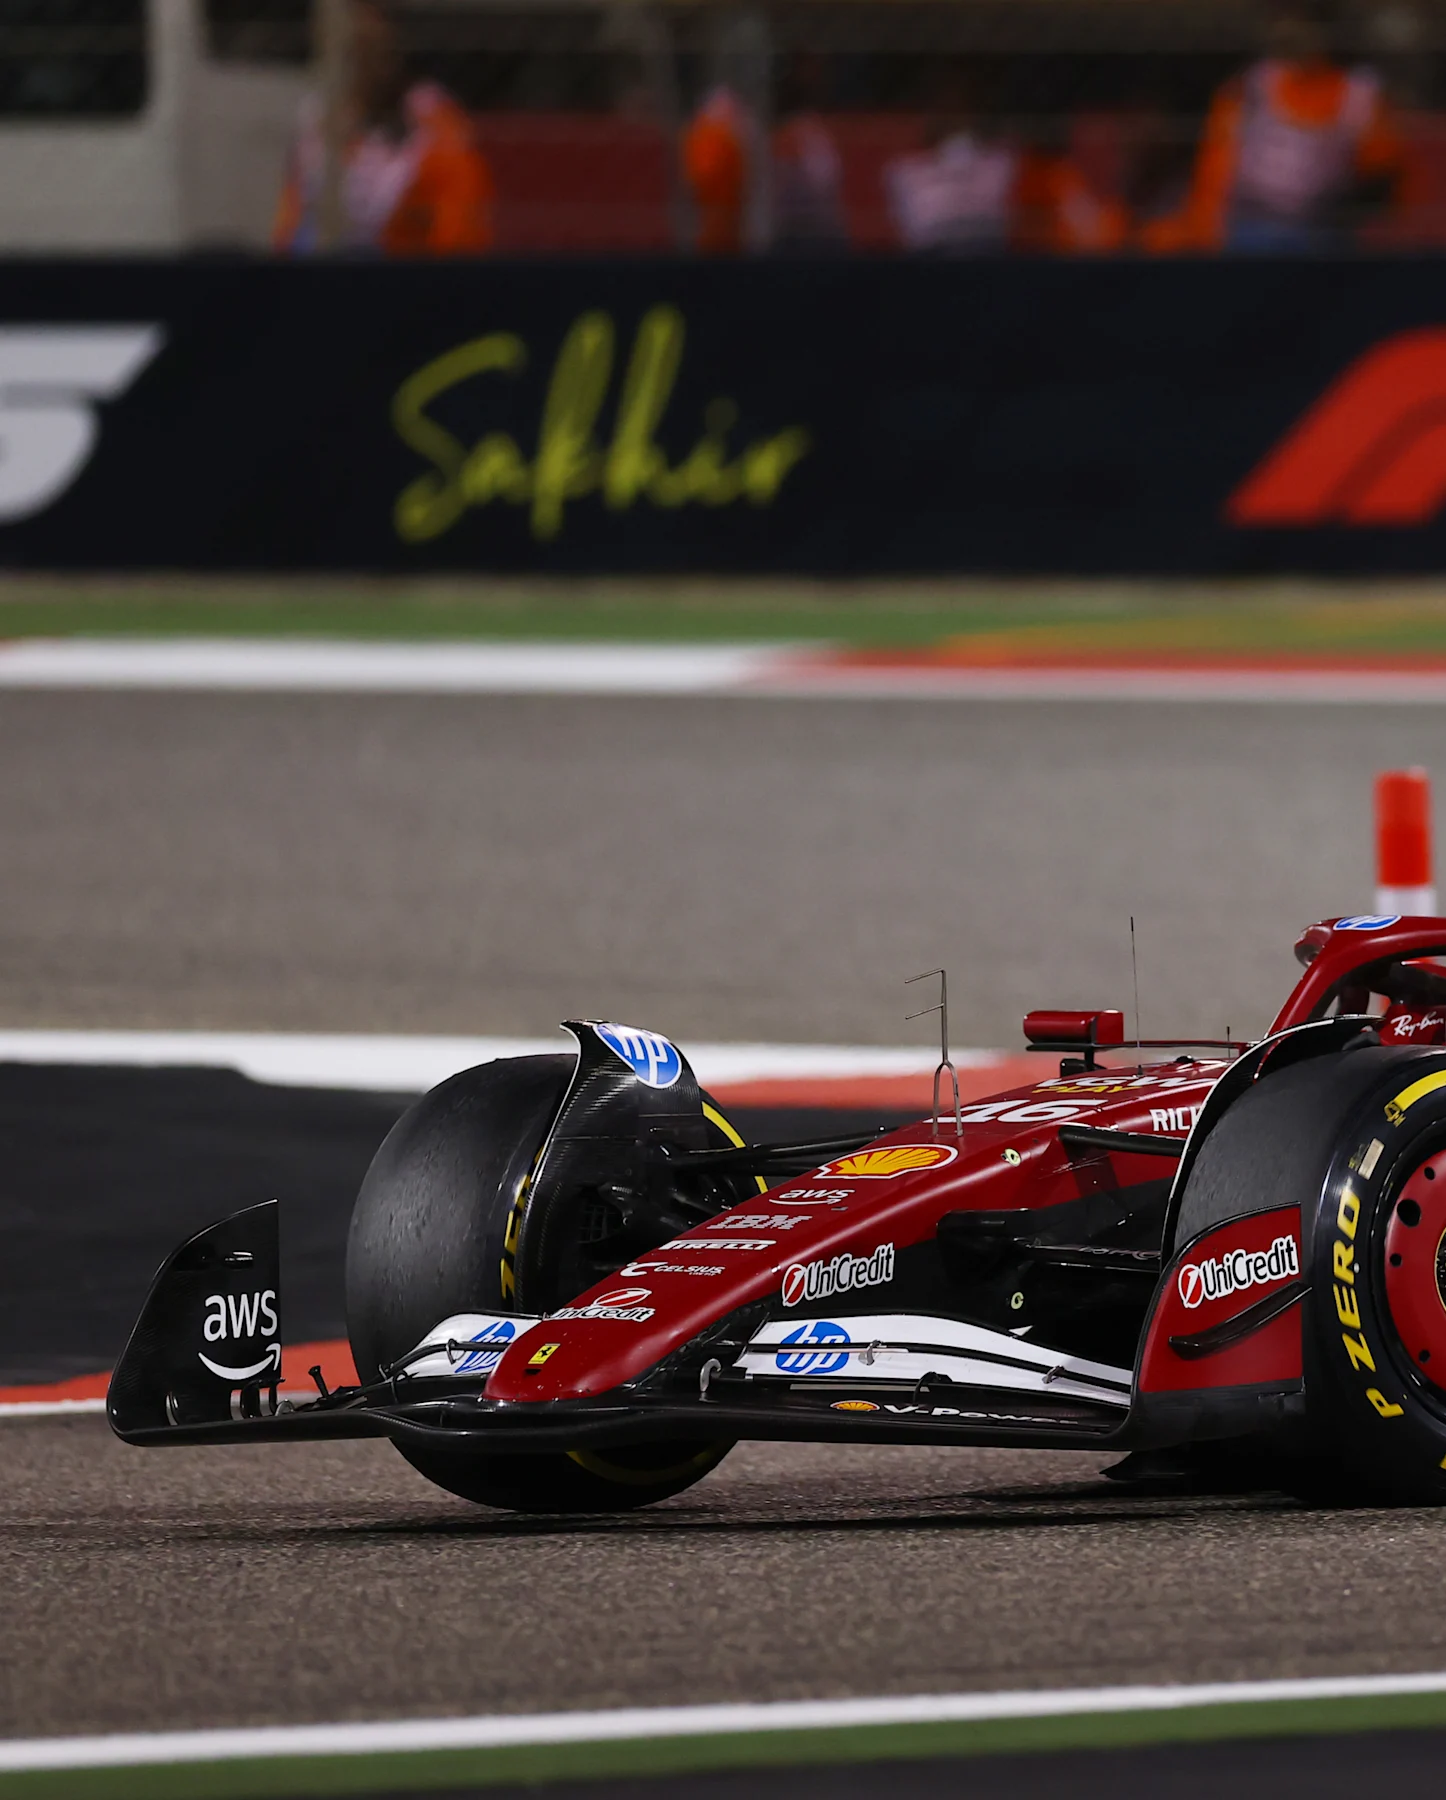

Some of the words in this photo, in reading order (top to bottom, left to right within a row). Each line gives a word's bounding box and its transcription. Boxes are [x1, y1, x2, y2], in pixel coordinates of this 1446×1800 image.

[392, 304, 810, 541] Sakhir
[925, 1099, 1109, 1123] 16
[779, 1189, 855, 1200] aws
[706, 1215, 813, 1230] IBM
[658, 1239, 777, 1251] PIRELLI
[653, 1265, 726, 1275] CELSIUS
[804, 1243, 895, 1300] UniCredit
[1201, 1235, 1299, 1300] UniCredit
[1333, 1186, 1377, 1373] ZERO
[203, 1289, 278, 1342] aws
